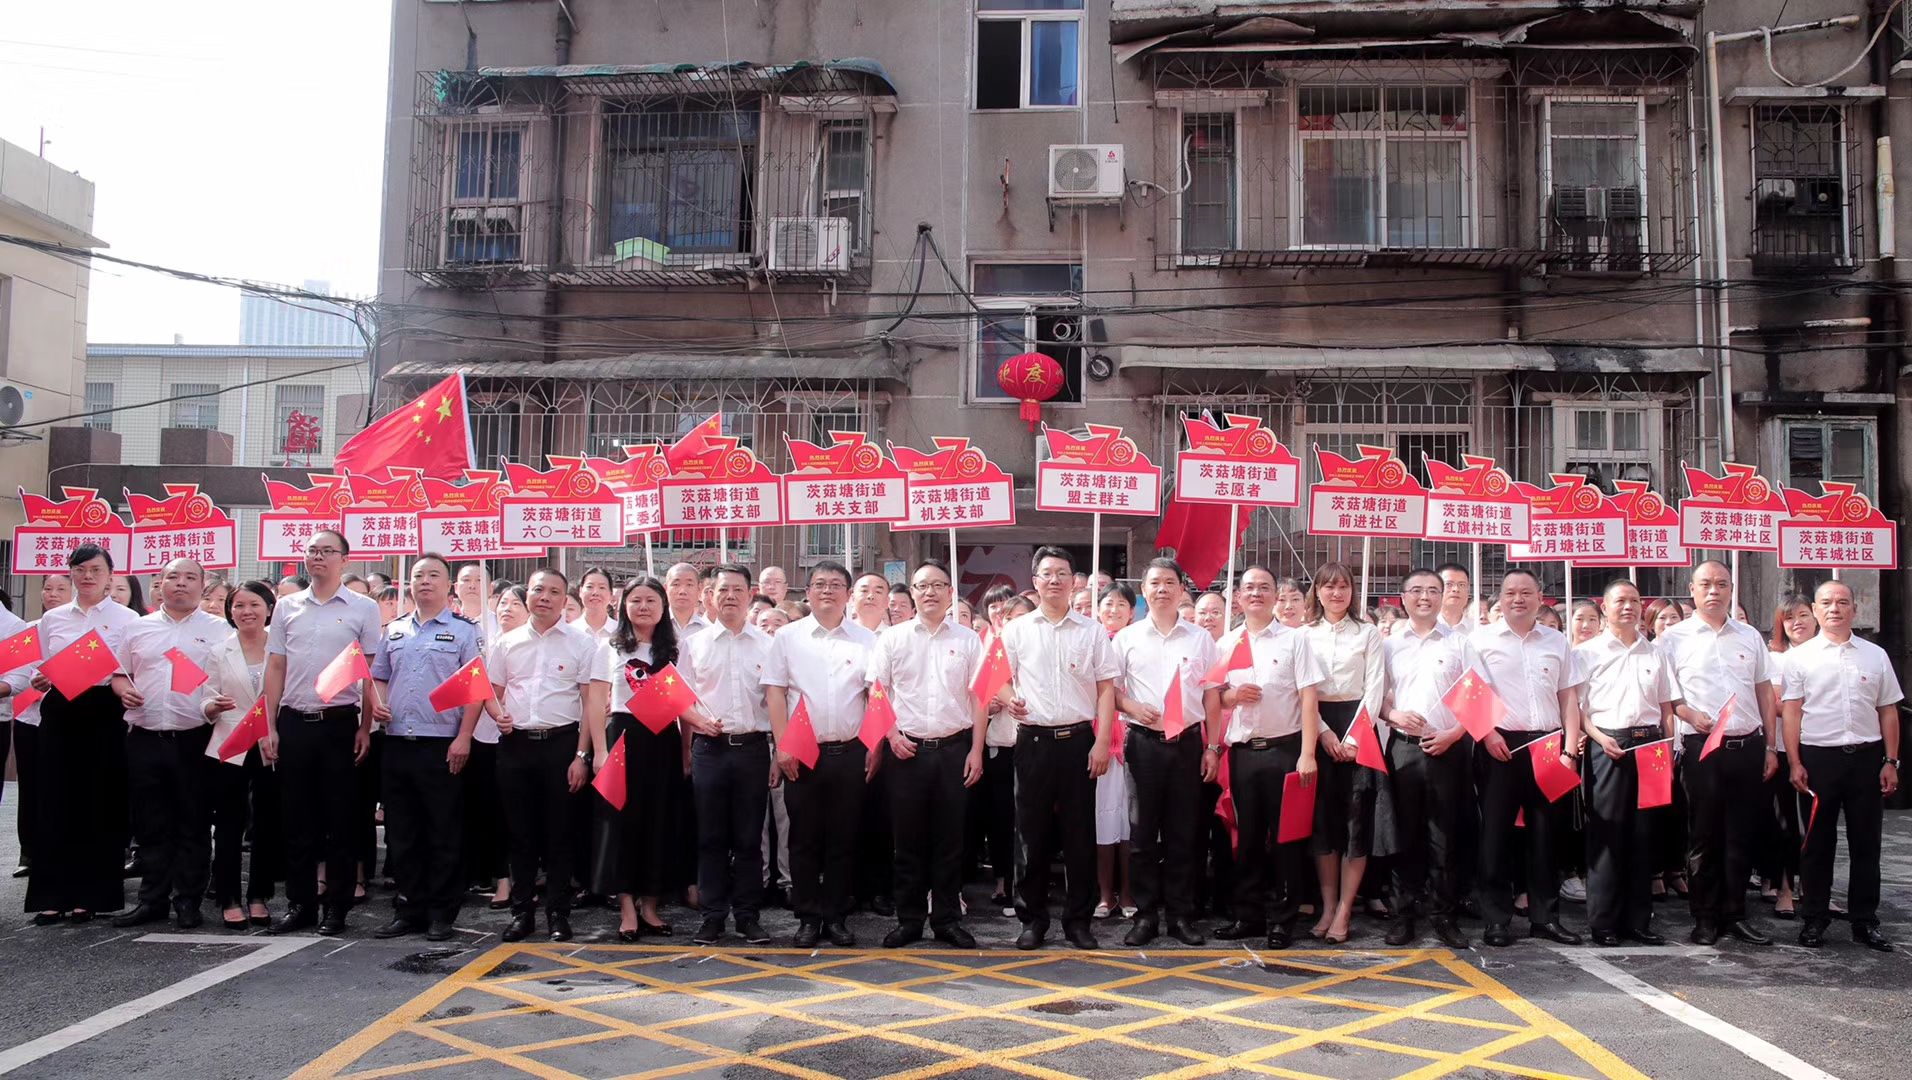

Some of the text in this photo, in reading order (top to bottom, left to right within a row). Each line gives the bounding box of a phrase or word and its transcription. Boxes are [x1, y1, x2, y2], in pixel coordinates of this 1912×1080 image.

[1199, 463, 1278, 481] 茨菇塘街道
[1059, 472, 1139, 490] 茨菇塘街道
[681, 487, 760, 503] 茨菇塘街道
[807, 482, 887, 498] 茨菇塘街道
[911, 486, 991, 505] 茨菇塘街道
[1214, 482, 1262, 498] 志愿者
[1066, 490, 1130, 507] 盟主群主
[1331, 495, 1407, 513] 茨菇塘街道
[522, 507, 602, 522] 茨菇塘街道
[682, 505, 761, 521] 退休党支部
[815, 500, 879, 516] 机关支部
[920, 504, 984, 521] 机关支部
[1442, 503, 1513, 520] 茨菇塘街道
[1338, 513, 1398, 530] 前进社区
[1700, 511, 1773, 528] 茨菇塘街道
[282, 522, 341, 537] 茨菇塘
[522, 525, 602, 539] 六〇一社区
[1442, 520, 1513, 537] 红旗村社区
[1532, 522, 1606, 537] 茨菇塘街道
[1700, 528, 1772, 544] 余家冲社区
[35, 536, 112, 551] 茨菇塘街道
[144, 530, 216, 550] 茨菇塘街道
[451, 537, 499, 553] 天鹅社
[1529, 538, 1606, 554] 新月塘社区
[1799, 530, 1875, 546] 茨菇塘街道
[35, 553, 71, 568] 黄家
[1799, 547, 1875, 561] 汽车城社区
